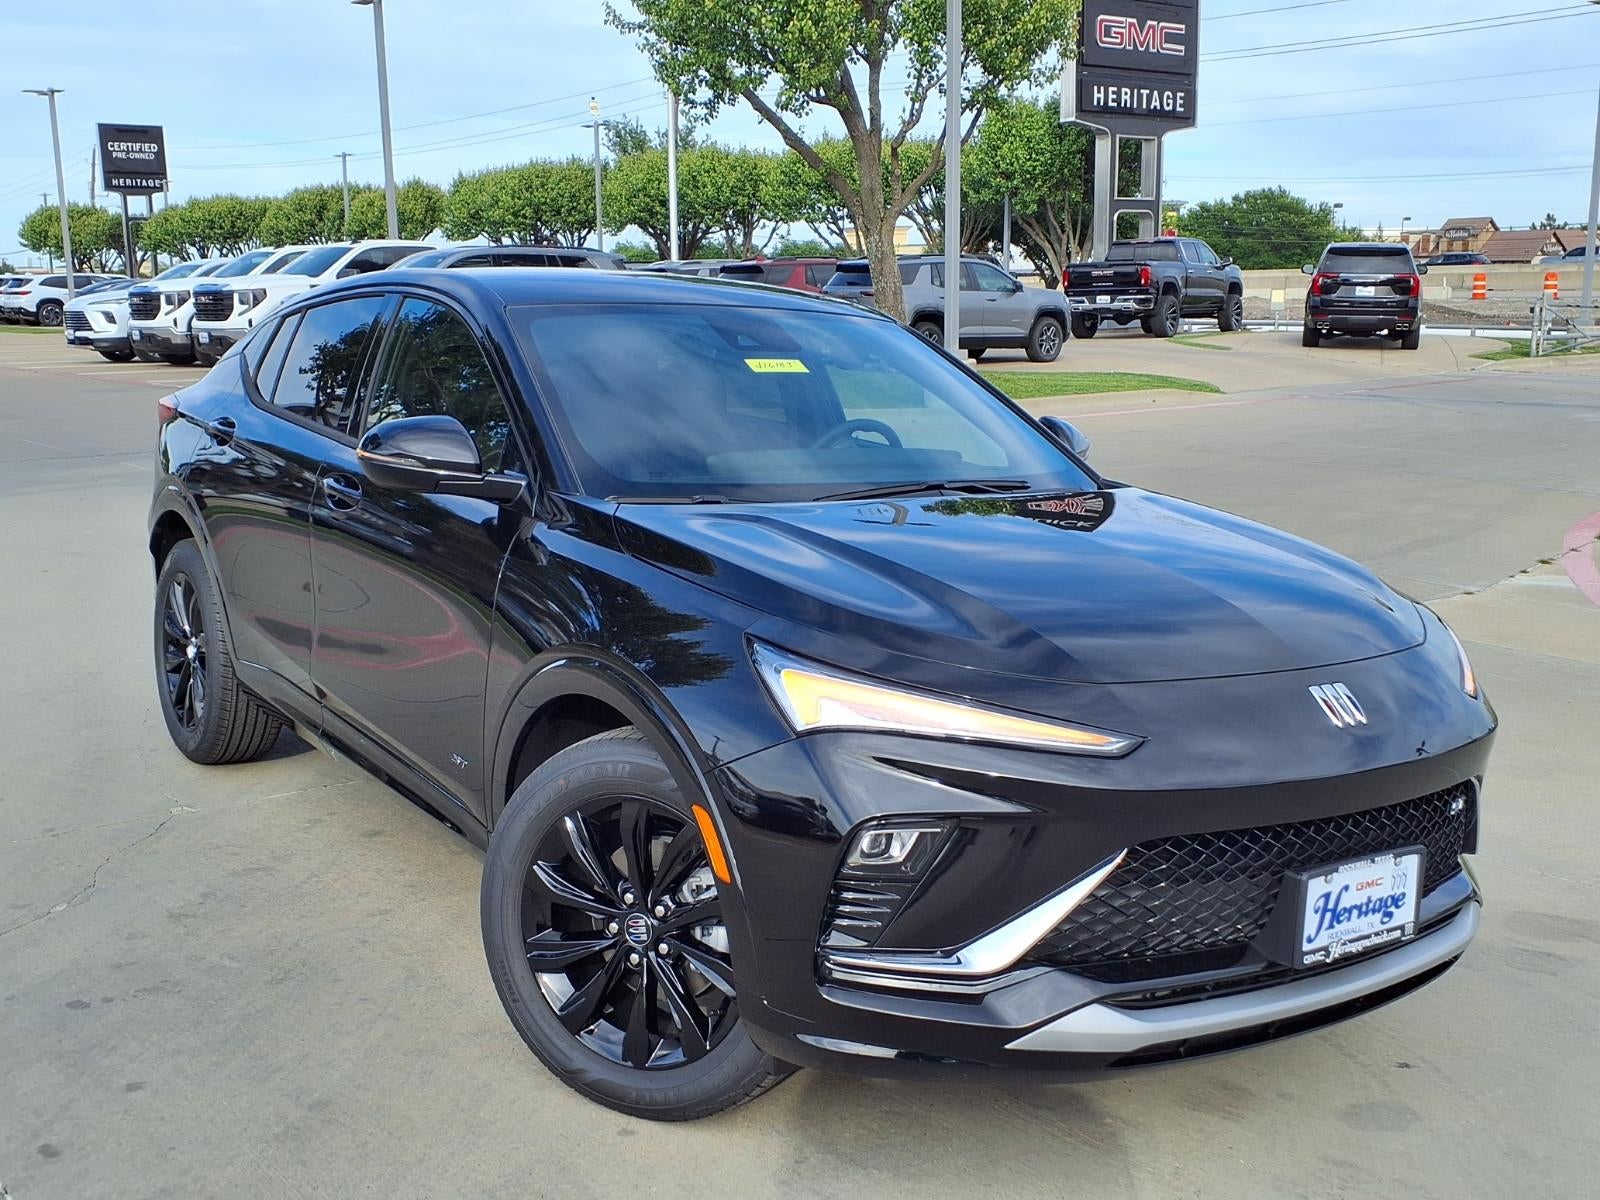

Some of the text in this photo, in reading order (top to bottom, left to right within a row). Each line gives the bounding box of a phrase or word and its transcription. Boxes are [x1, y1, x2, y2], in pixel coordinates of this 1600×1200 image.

[1097, 14, 1186, 56] GMC
[1093, 85, 1185, 112] HERITAGE
[107, 141, 159, 152] CERTIFIED
[112, 151, 155, 160] PRE-OWNED
[112, 178, 161, 187] HERITAGE
[1355, 876, 1385, 892] GMC
[1305, 883, 1407, 945] Heritage
[1303, 950, 1326, 964] GMC
